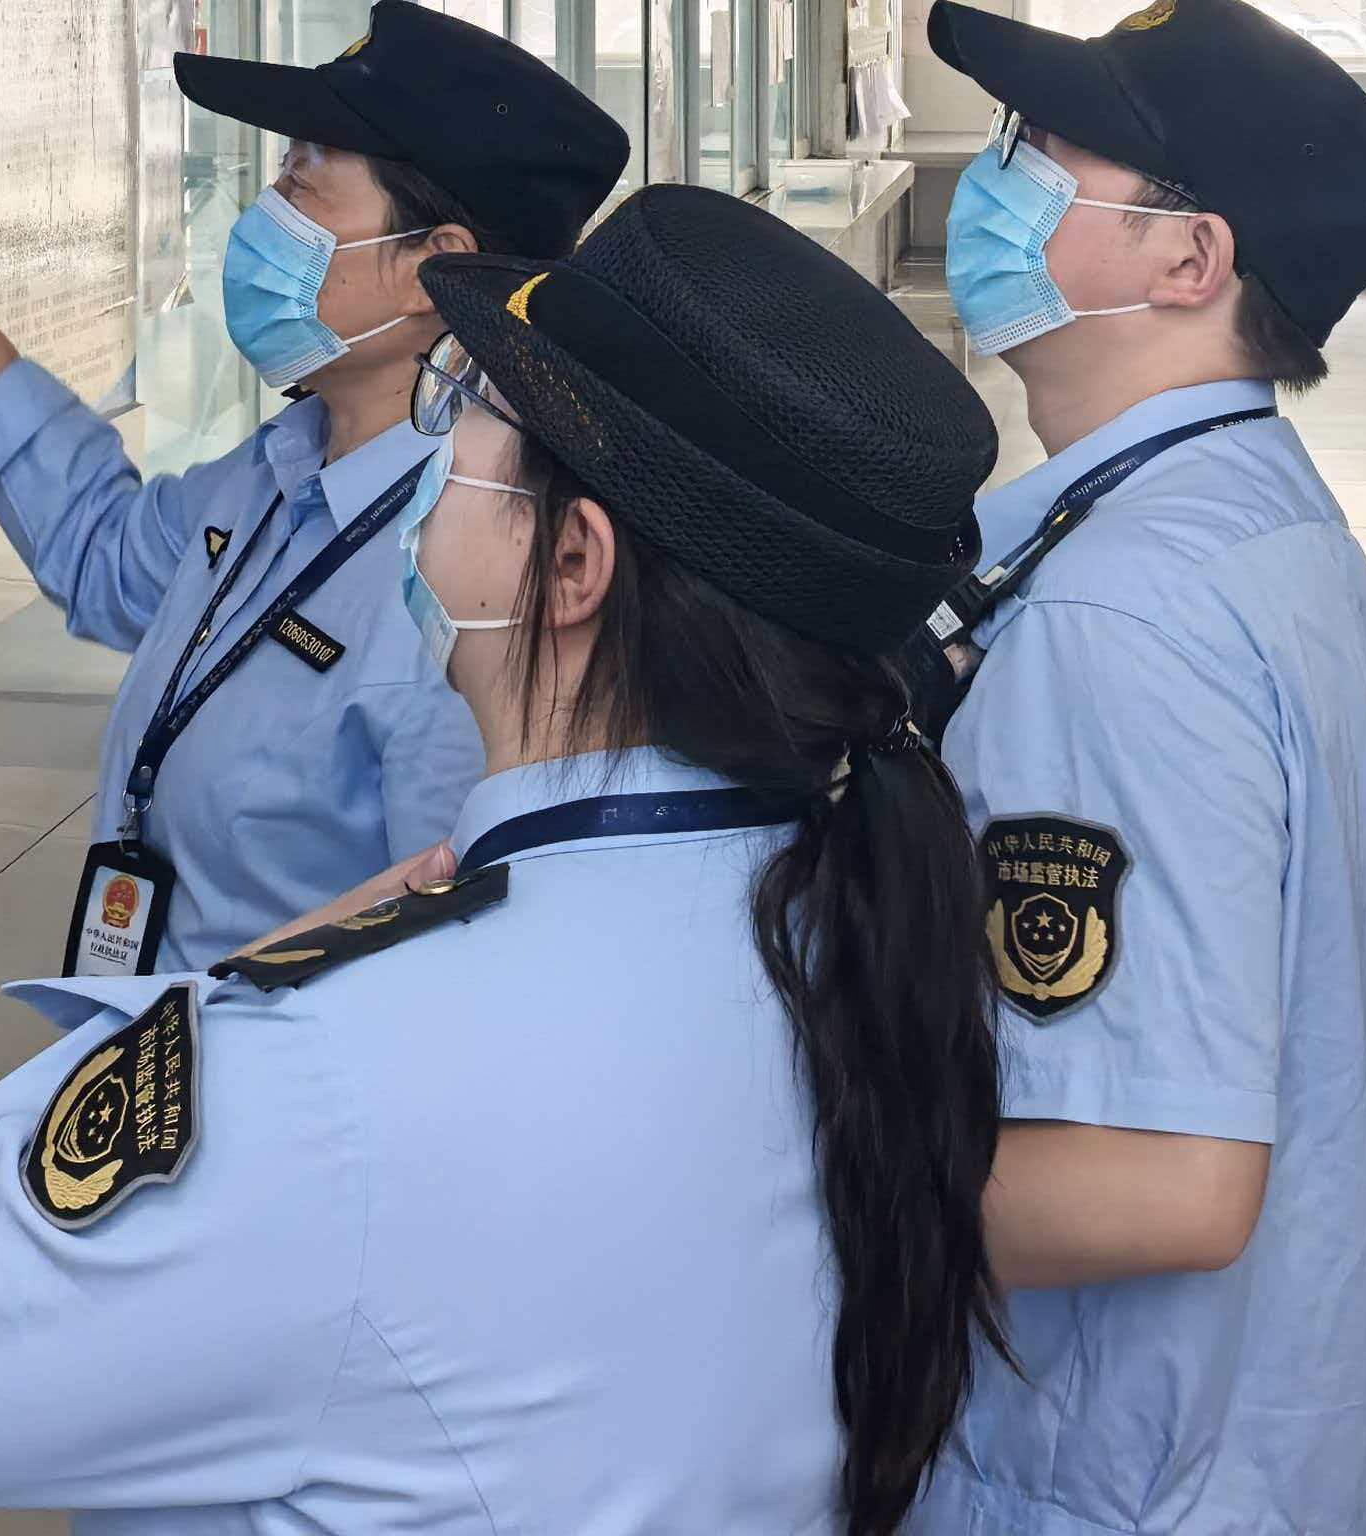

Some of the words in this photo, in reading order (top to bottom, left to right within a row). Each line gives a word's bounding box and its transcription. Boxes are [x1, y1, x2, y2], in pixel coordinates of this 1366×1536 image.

[278, 616, 337, 664] 12060530107
[987, 830, 1112, 869] 中华人民共和国
[997, 862, 1099, 889] 市场监管执法
[136, 1023, 160, 1155] 市场监管执法
[160, 999, 181, 1151] 中华人民共和国
